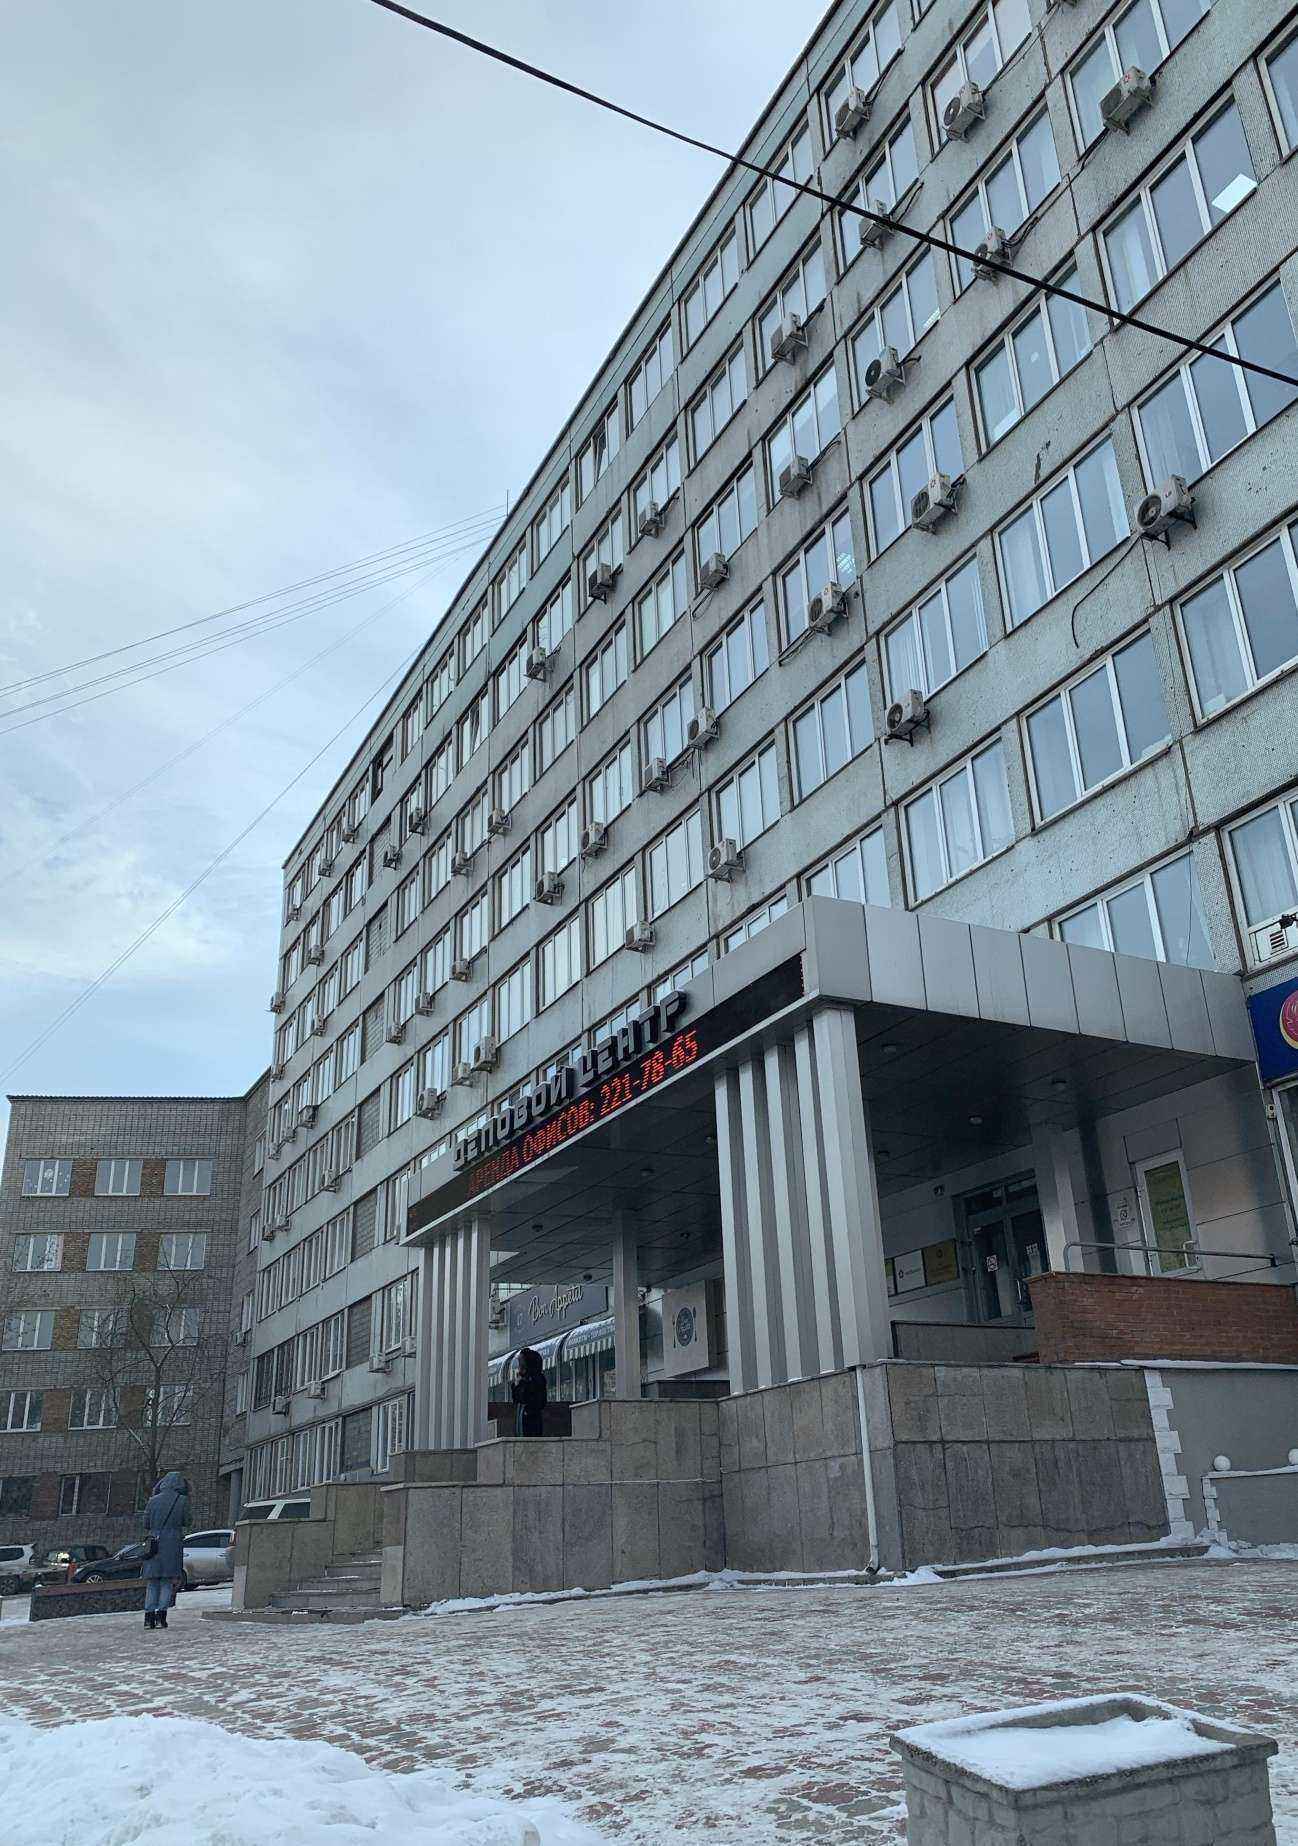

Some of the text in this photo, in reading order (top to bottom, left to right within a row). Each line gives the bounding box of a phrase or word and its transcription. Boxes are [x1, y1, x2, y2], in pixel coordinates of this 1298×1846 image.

[453, 990, 686, 1171] ДЕЛОВОЙ ЦЕНТР
[600, 1031, 697, 1115] 221-78-65
